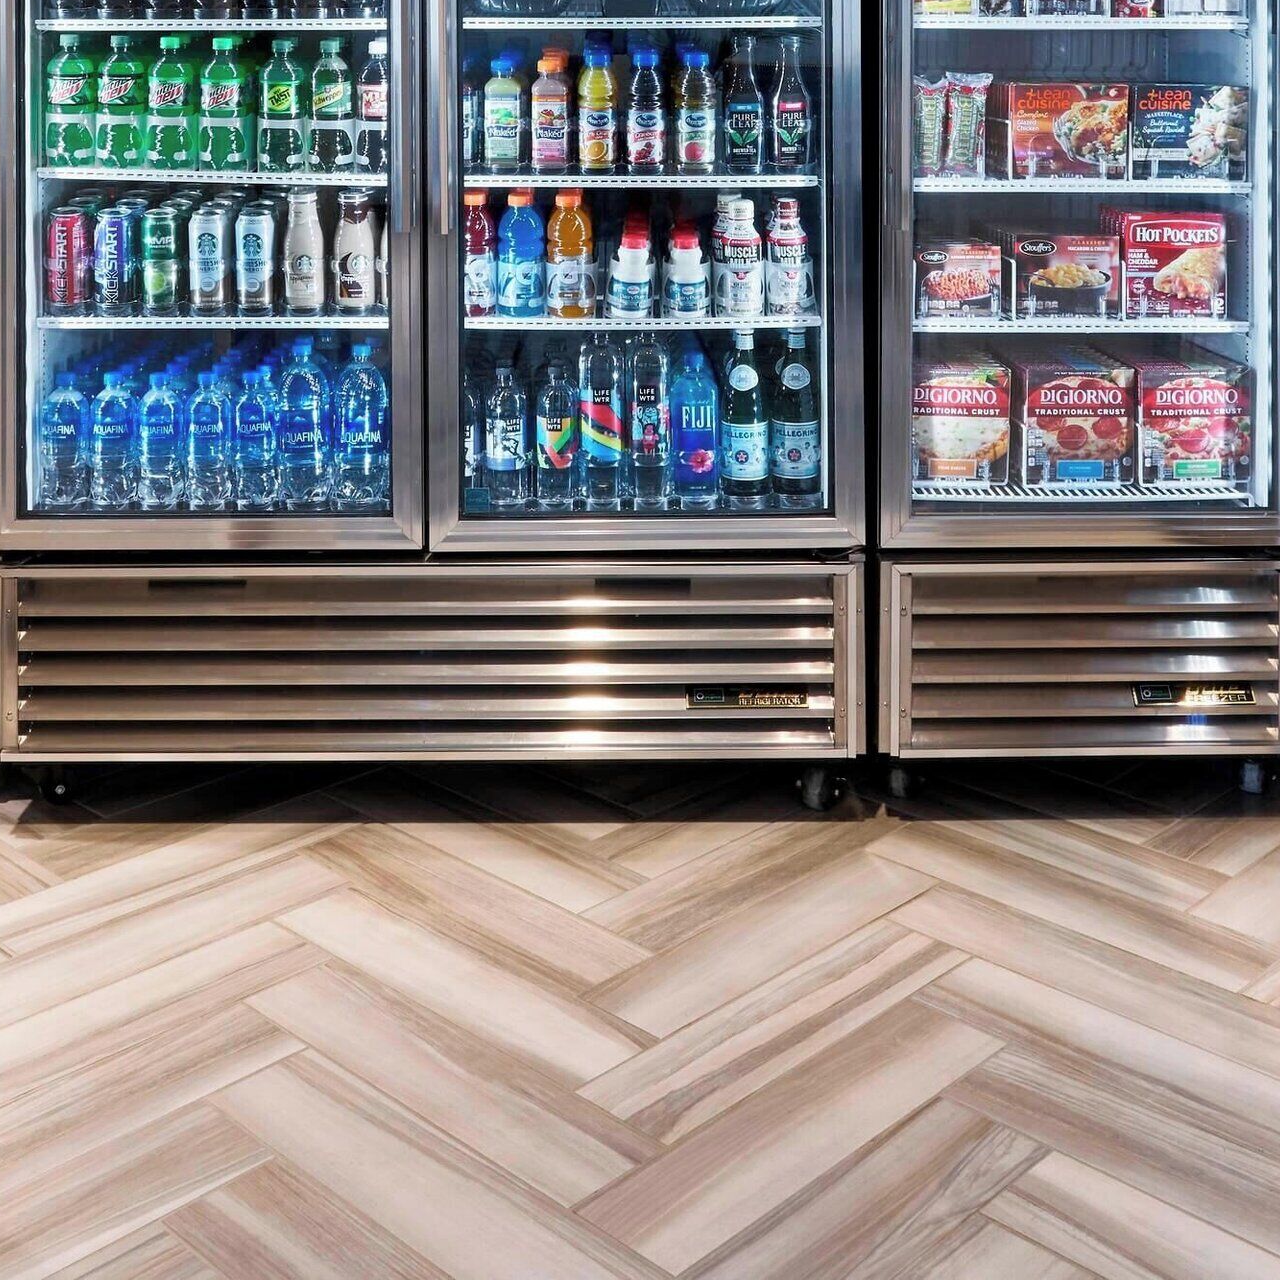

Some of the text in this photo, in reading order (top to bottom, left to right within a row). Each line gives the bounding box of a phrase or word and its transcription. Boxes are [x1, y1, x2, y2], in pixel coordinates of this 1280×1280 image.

[782, 112, 803, 120] PURE
[537, 127, 565, 139] Naked
[1135, 227, 1219, 244] HOT POCKETS
[724, 245, 758, 258] MUSCLE
[1024, 243, 1053, 253] Stouffer's
[682, 405, 712, 428] FIJI
[913, 406, 1001, 416] RADITIONAL CRUST
[1034, 408, 1126, 416] TRADITIONAL CRUST
[1150, 407, 1243, 416] TRADITIONAL CRUST
[93, 424, 128, 435] AQUAFINA
[237, 422, 272, 434] AQUAFINA
[283, 430, 323, 444] QUAFINA
[726, 429, 767, 440] PELLEGRNO
[1185, 694, 1248, 702] FREEZER
